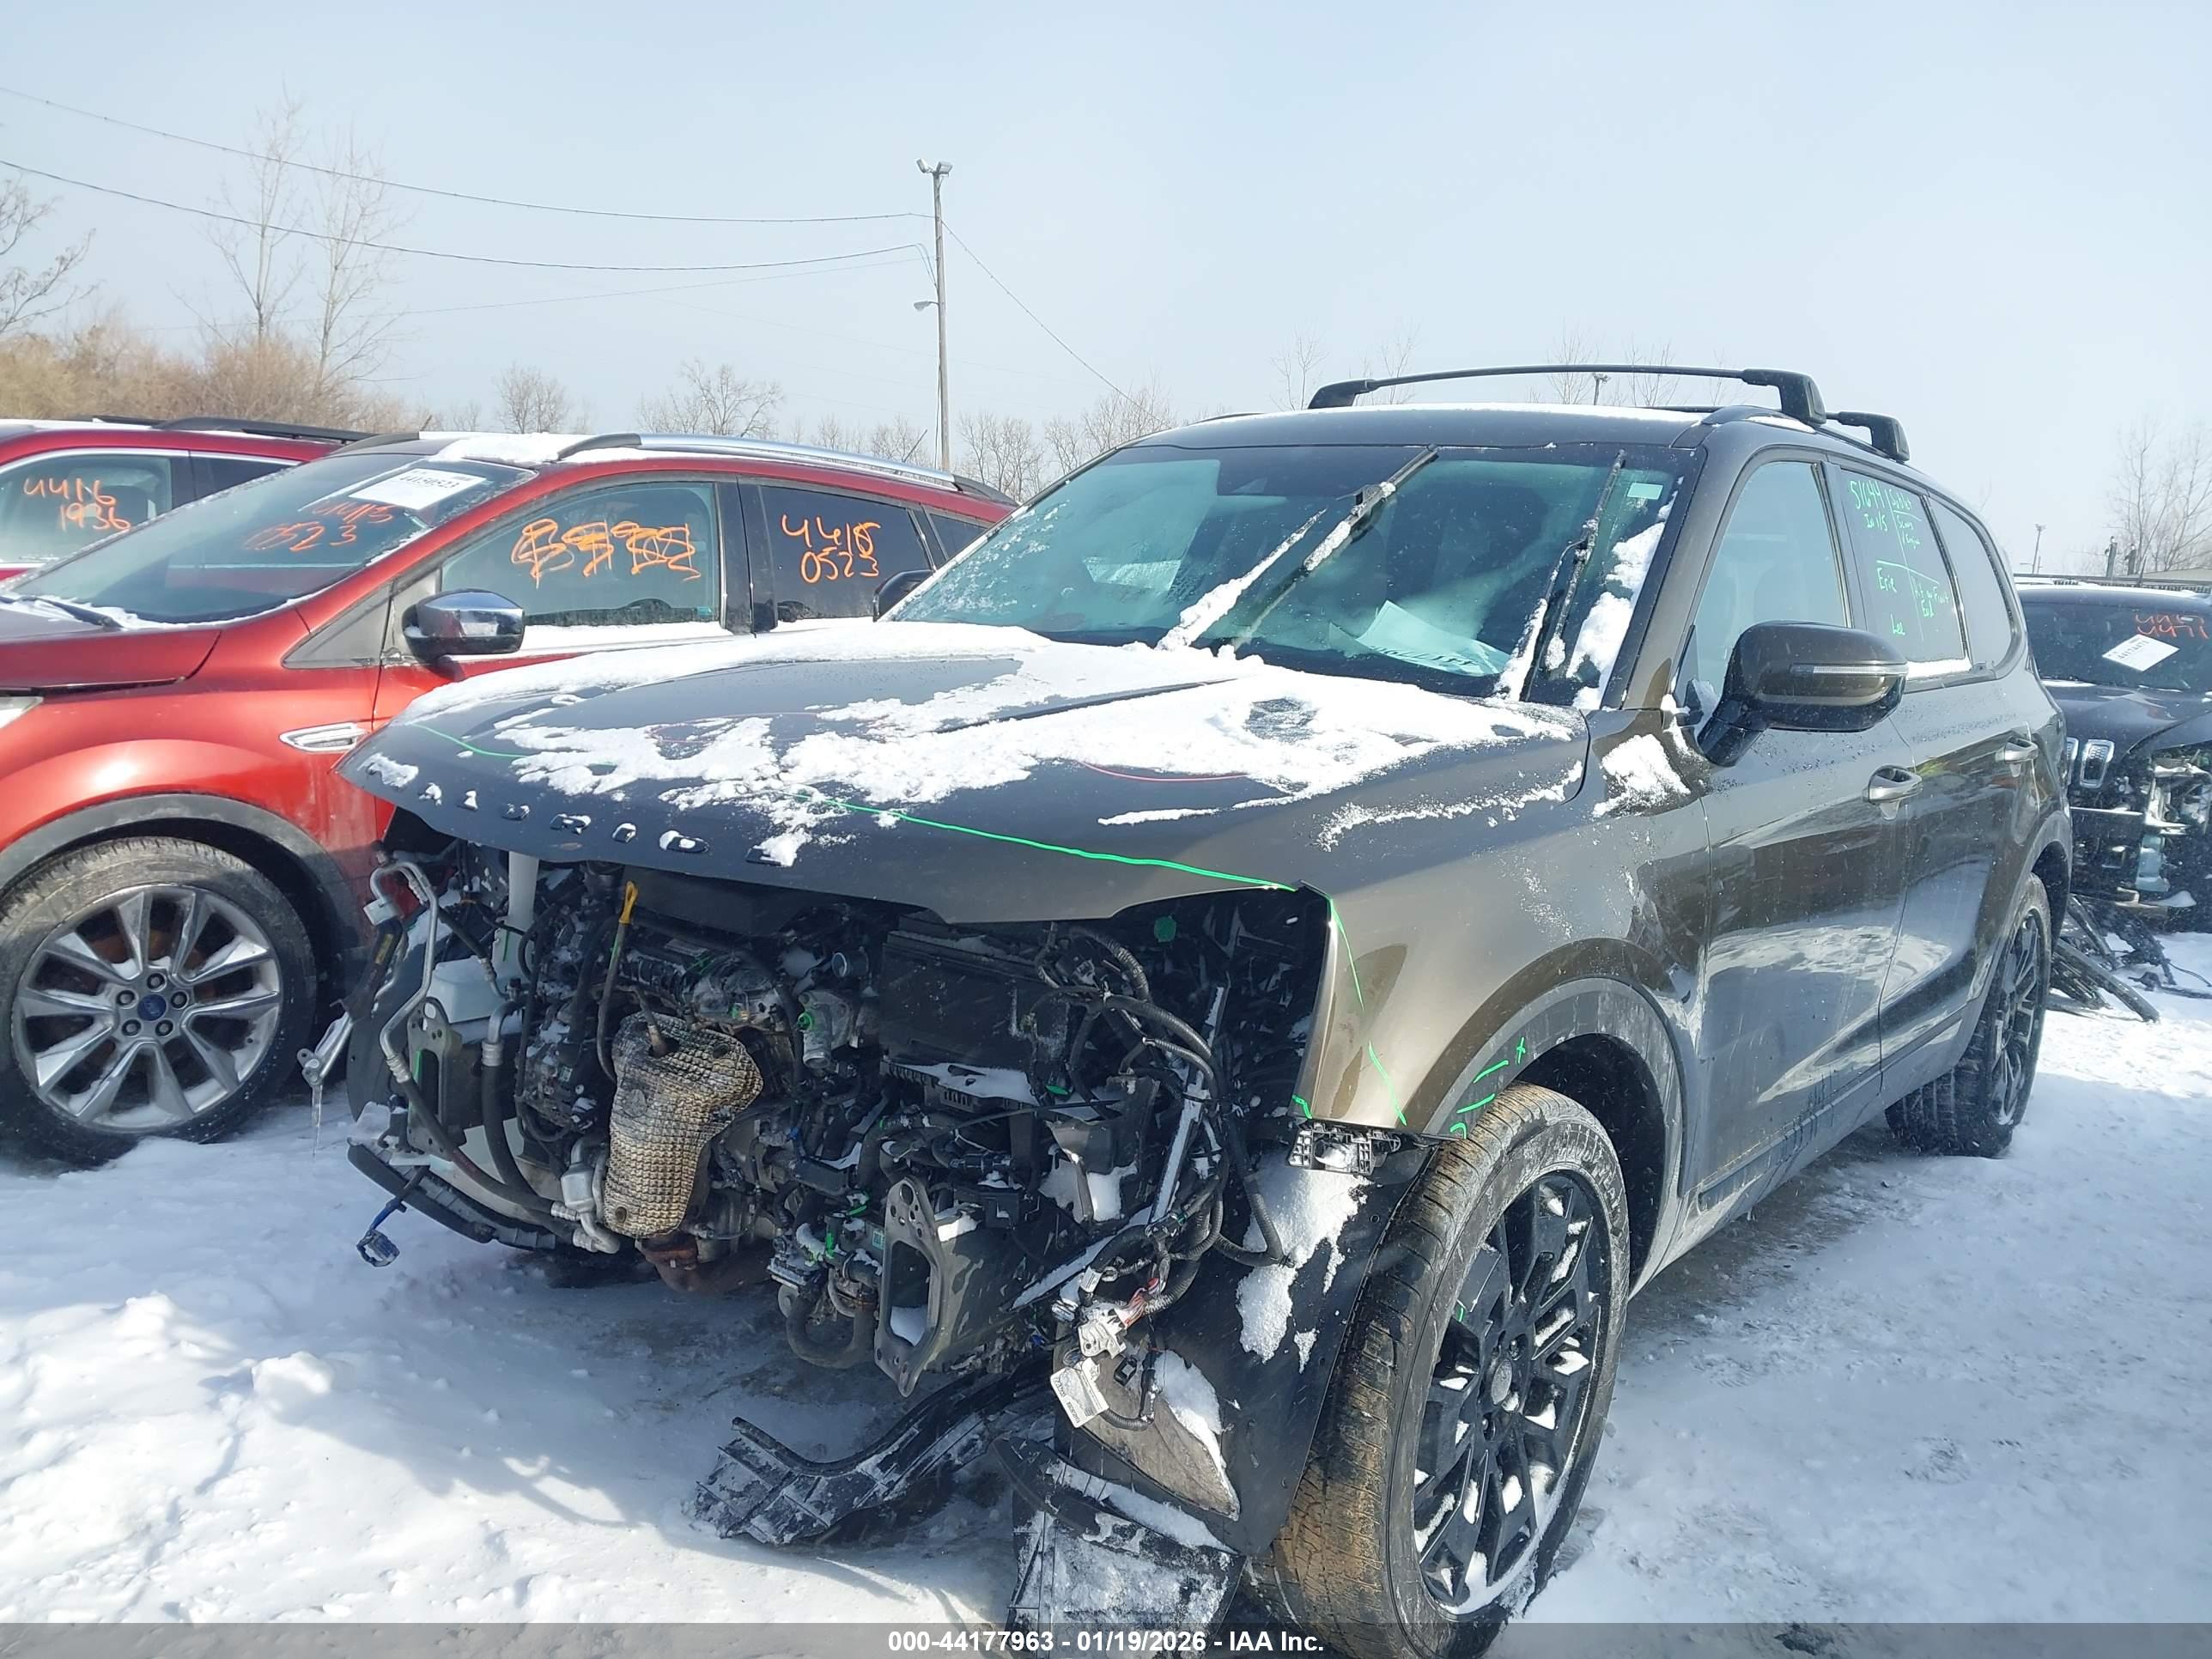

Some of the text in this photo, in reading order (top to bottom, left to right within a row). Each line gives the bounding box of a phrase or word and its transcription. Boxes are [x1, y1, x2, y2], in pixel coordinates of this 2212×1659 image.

[23, 477, 117, 507] 4416
[59, 501, 131, 532] 1936
[800, 545, 879, 584] 0523
[366, 752, 803, 867] LURIDE
